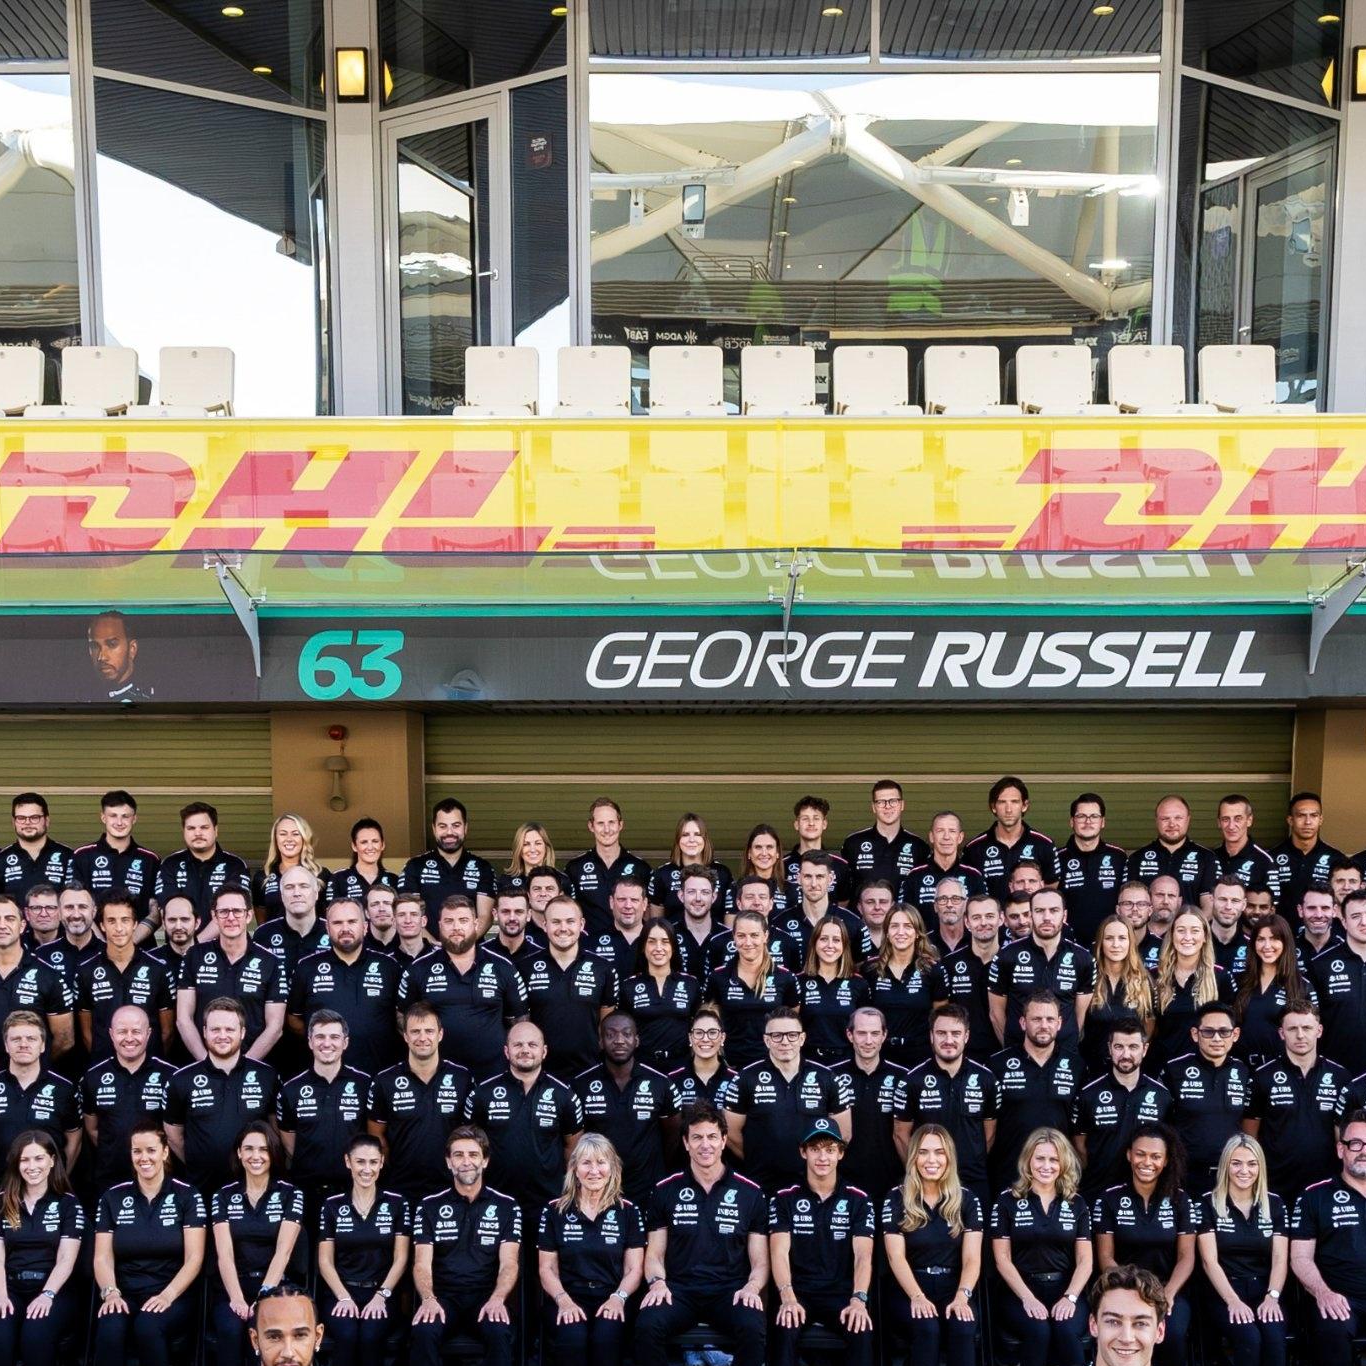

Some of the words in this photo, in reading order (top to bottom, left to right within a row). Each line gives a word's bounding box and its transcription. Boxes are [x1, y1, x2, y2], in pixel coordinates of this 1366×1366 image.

[297, 630, 403, 700] 63
[585, 630, 917, 689] GEORGE
[918, 631, 1266, 688] RUSSELL
